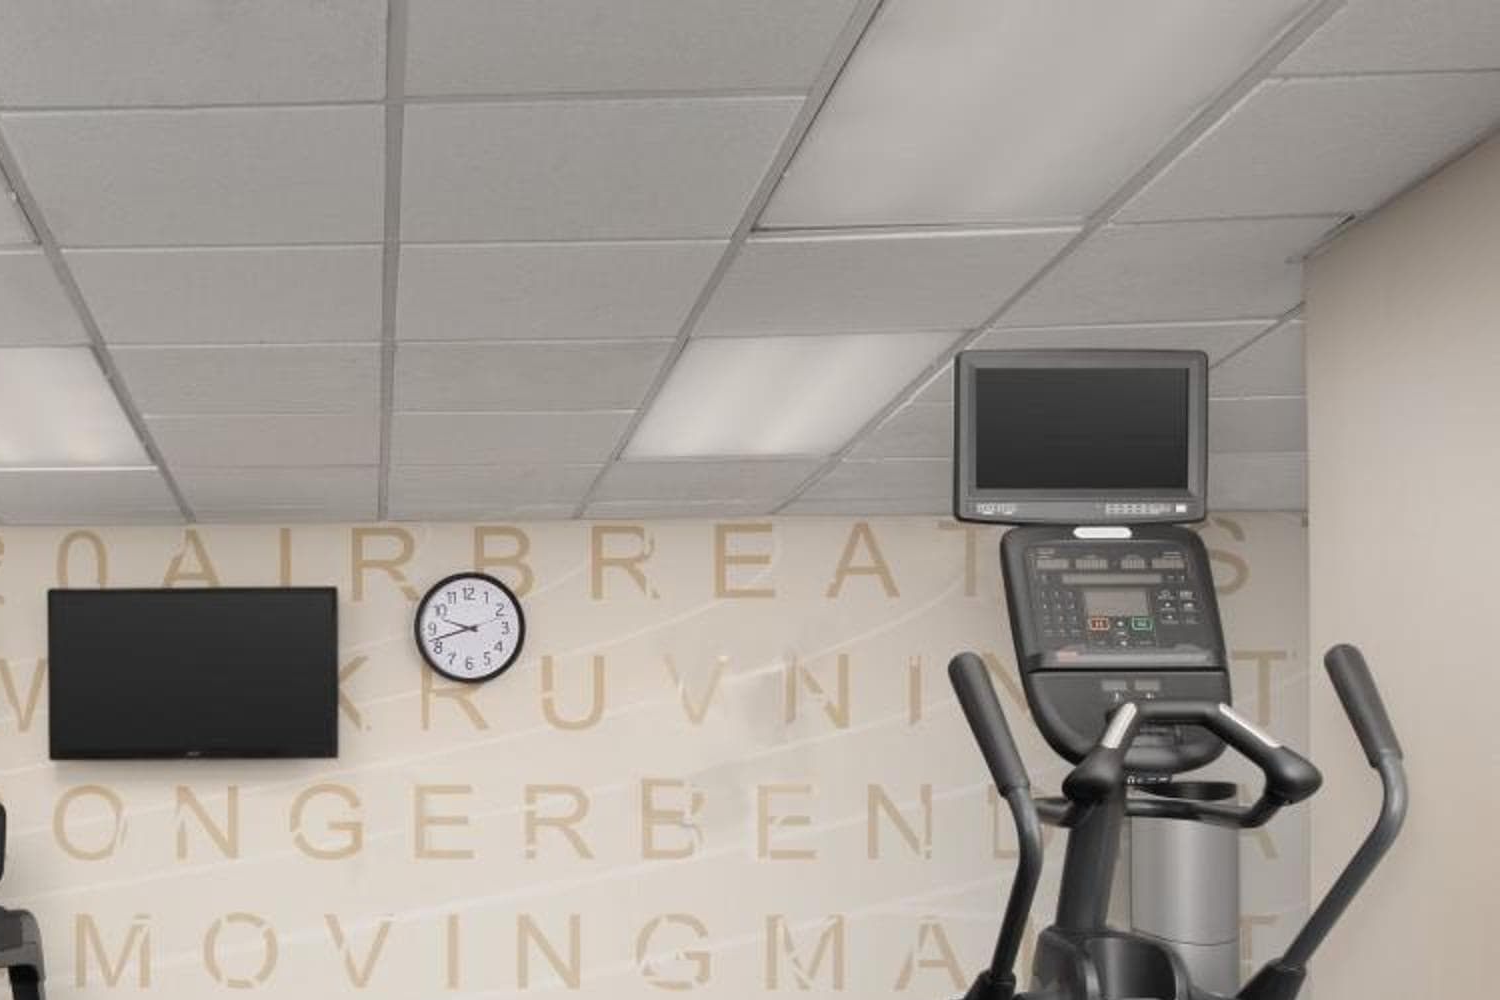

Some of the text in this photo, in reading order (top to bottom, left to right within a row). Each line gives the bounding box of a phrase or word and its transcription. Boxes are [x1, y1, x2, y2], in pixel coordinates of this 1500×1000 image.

[447, 591, 457, 604] 11
[462, 587, 476, 600] 12
[483, 591, 489, 604] 1
[434, 603, 447, 616] 10
[495, 602, 505, 617] 2
[428, 622, 437, 636] 9
[501, 621, 510, 635] 3
[433, 640, 443, 654] 8
[494, 641, 503, 653] 4
[448, 652, 456, 665] 7
[465, 656, 474, 670] 6
[483, 651, 492, 666] 5
